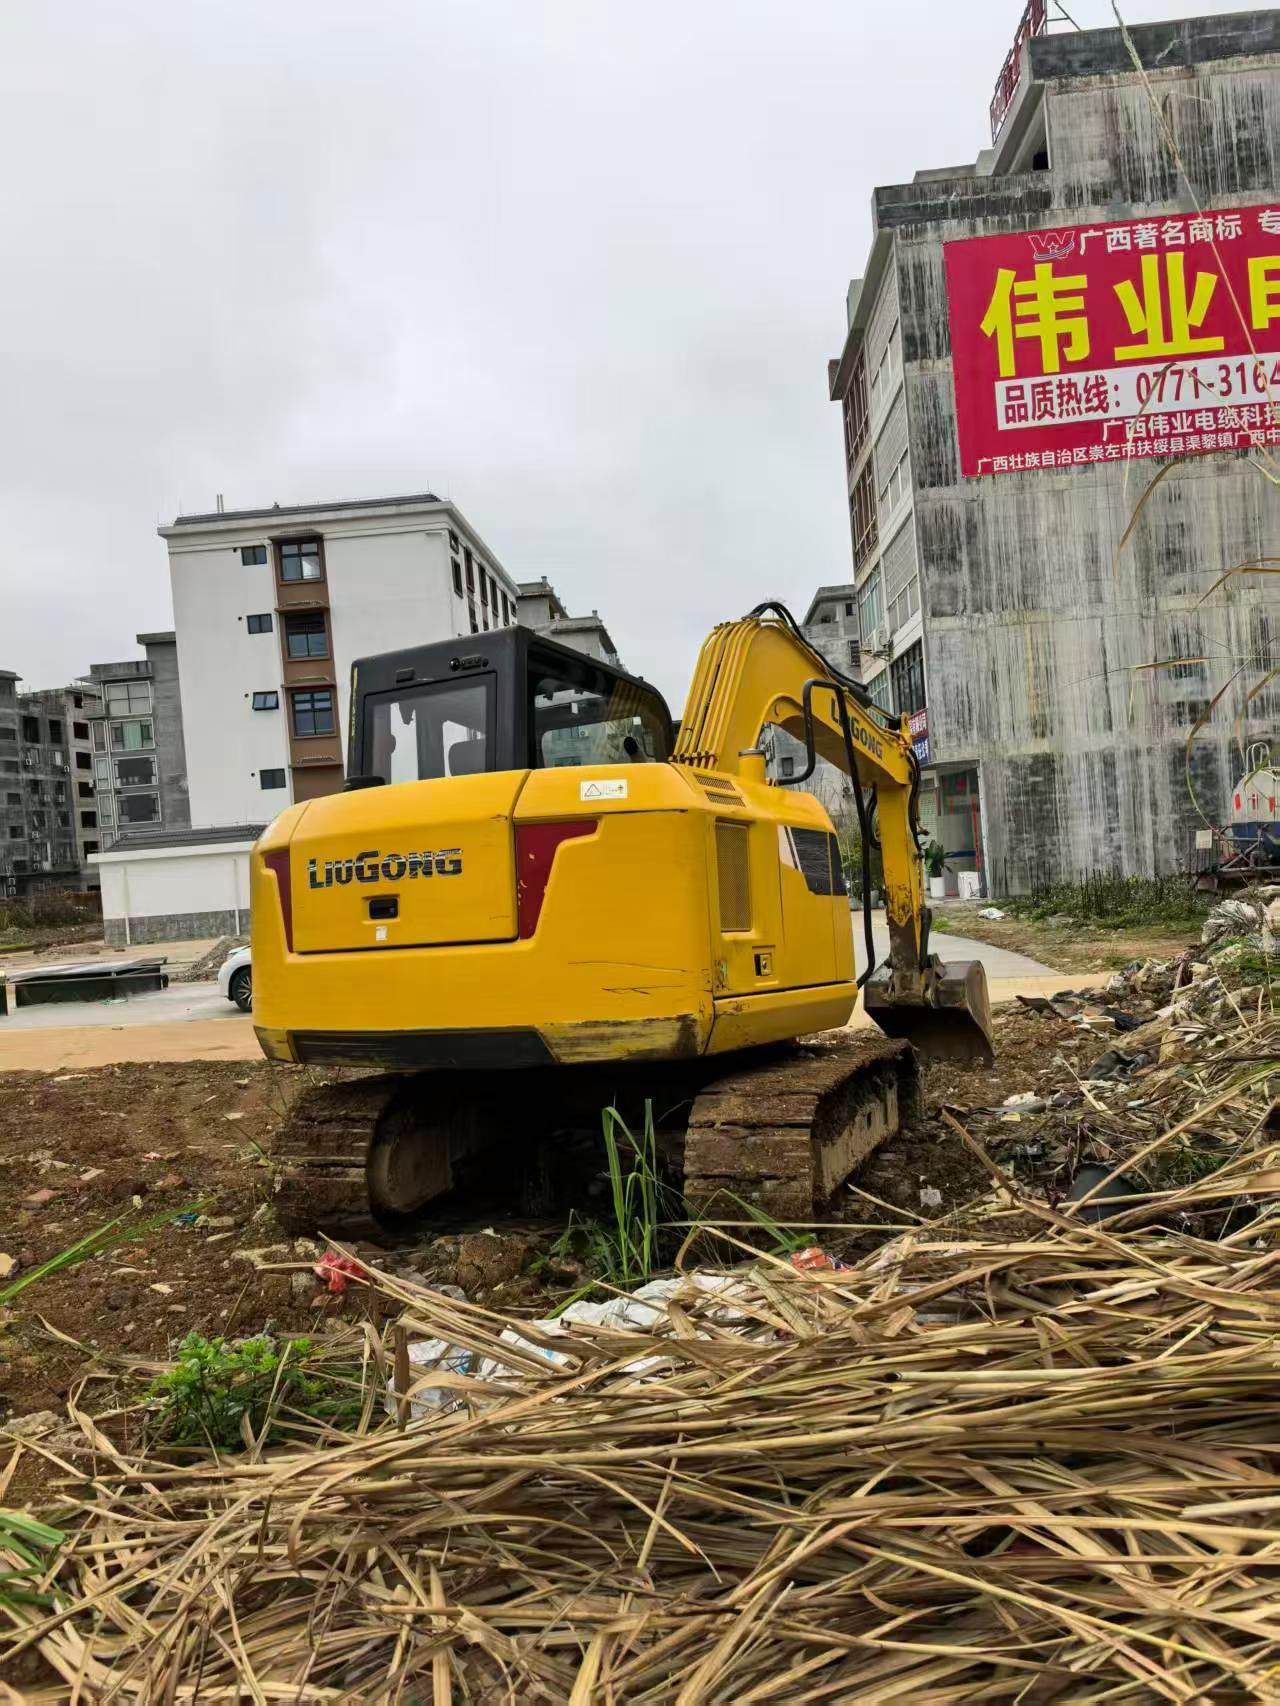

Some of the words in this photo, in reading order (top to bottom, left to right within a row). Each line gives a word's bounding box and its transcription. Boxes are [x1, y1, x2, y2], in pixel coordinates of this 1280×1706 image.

[1079, 214, 1242, 255] 广西著名商标
[831, 698, 883, 759] LGONG
